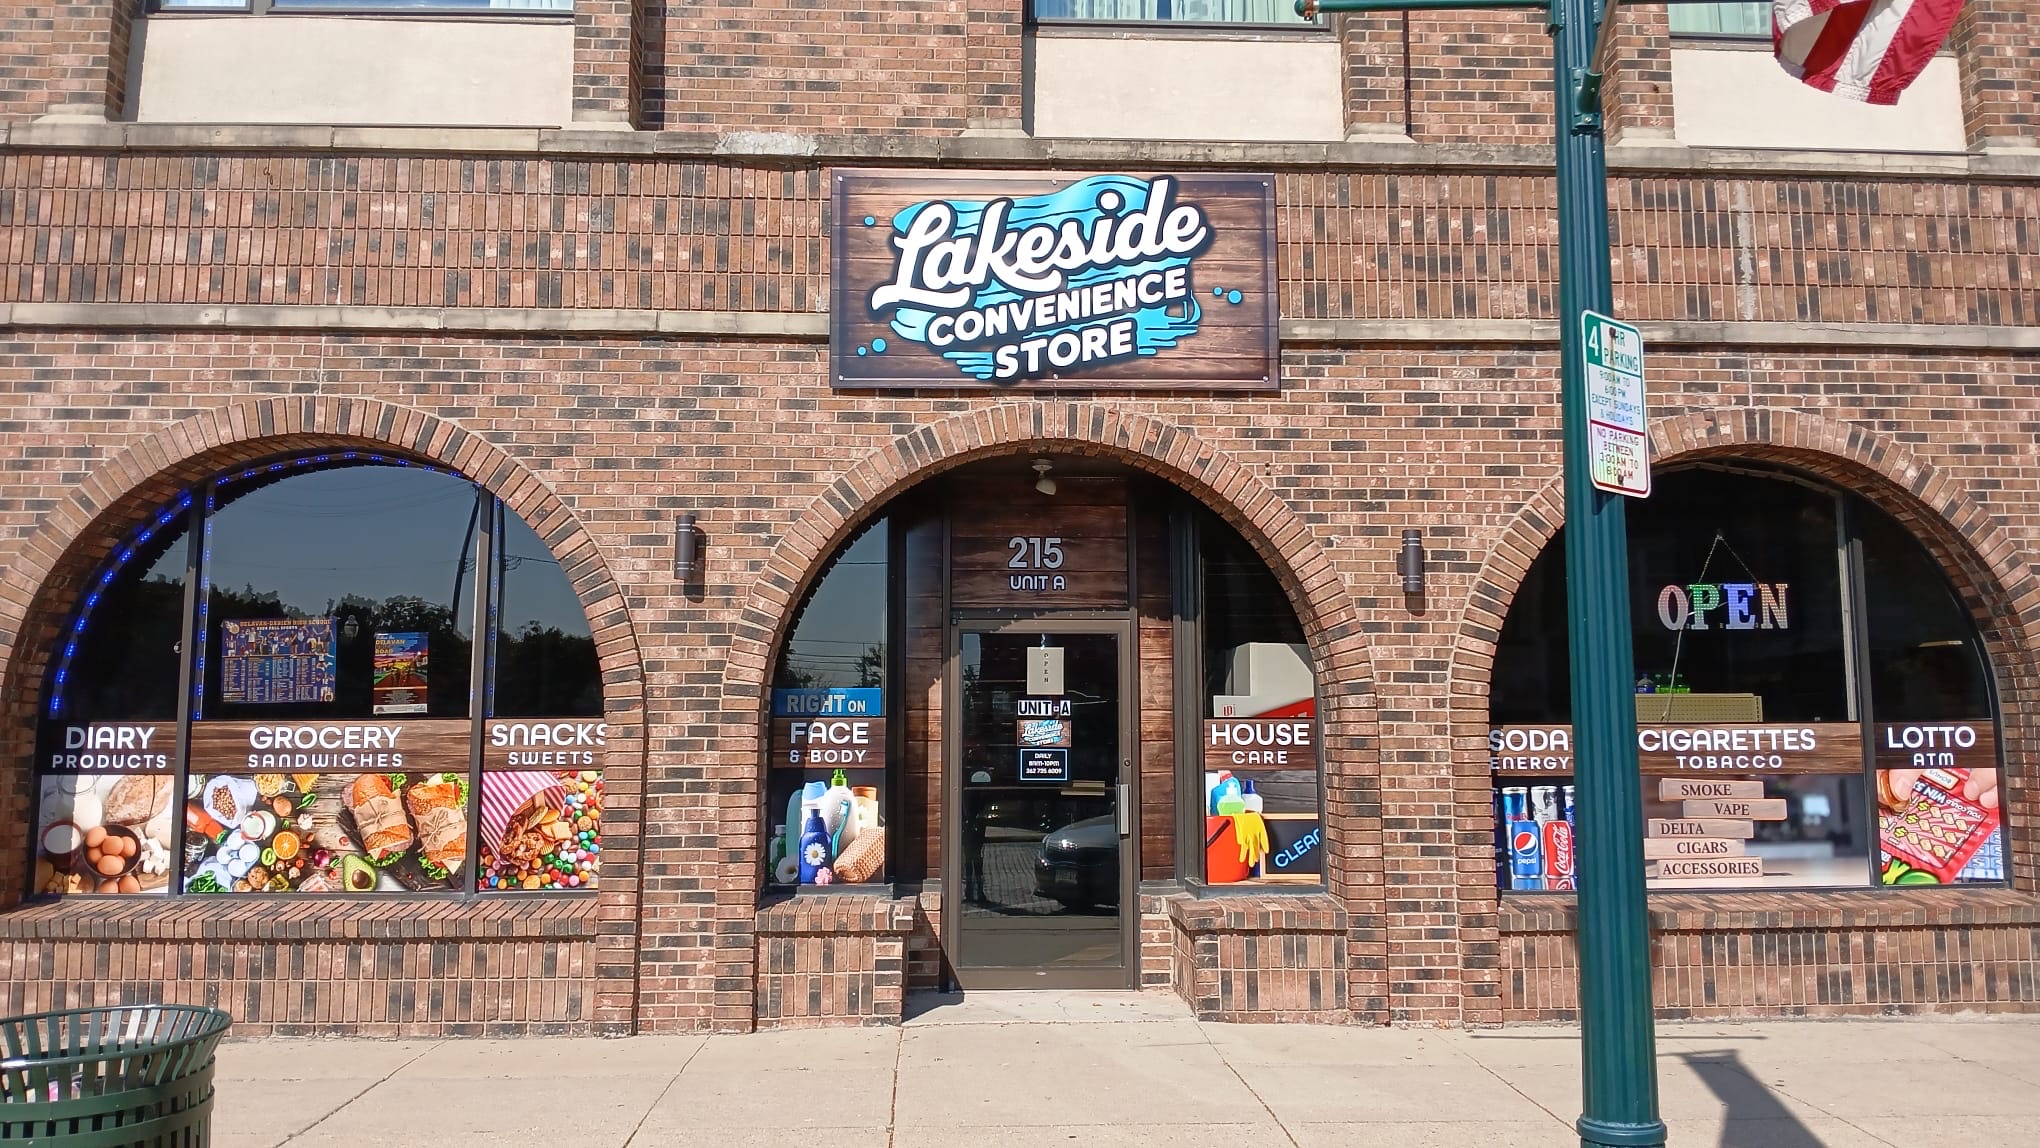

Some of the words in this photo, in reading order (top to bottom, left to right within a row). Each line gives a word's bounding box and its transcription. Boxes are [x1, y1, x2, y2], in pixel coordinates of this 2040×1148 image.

[870, 177, 1208, 311] Lakeside
[927, 267, 1186, 347] CONVENIENCE
[995, 320, 1133, 379] STORE
[1588, 326, 1600, 357] 4
[1603, 347, 1639, 373] PARKING
[1609, 430, 1640, 446] PARKING
[1603, 440, 1634, 457] BETWEEN
[1008, 536, 1065, 569] 215
[1010, 575, 1049, 590] UNIT
[1053, 575, 1065, 590] A
[1657, 583, 1789, 631] OPEN
[786, 694, 846, 713] RIGHT
[847, 700, 866, 713] ON
[65, 726, 156, 750] DIARY
[249, 725, 403, 750] GROCERY
[790, 721, 869, 744] FACE
[1211, 723, 1311, 746] HOUSE
[1488, 729, 1569, 752] SODA
[1637, 728, 1817, 752] CIGARETTES
[1887, 725, 1976, 749] LOTTO
[52, 754, 167, 769] PRODUCTS
[248, 753, 404, 769] SANDWICHES
[508, 750, 593, 765] SWEETS
[789, 749, 800, 763] &
[810, 749, 867, 763] BODY
[1231, 750, 1289, 765] CARE
[1490, 756, 1570, 770] ENERGY
[1676, 755, 1783, 769] TOBACCO
[1913, 752, 1954, 766] ATM
[1681, 784, 1733, 797] SMOKE
[1923, 786, 1947, 805] WIN
[1714, 802, 1750, 816] VAPE
[1660, 822, 1705, 835] DELTA
[1676, 841, 1728, 854] CIGARS
[1517, 856, 1537, 866] pepsi
[1662, 862, 1760, 876] ACCESSORIES
